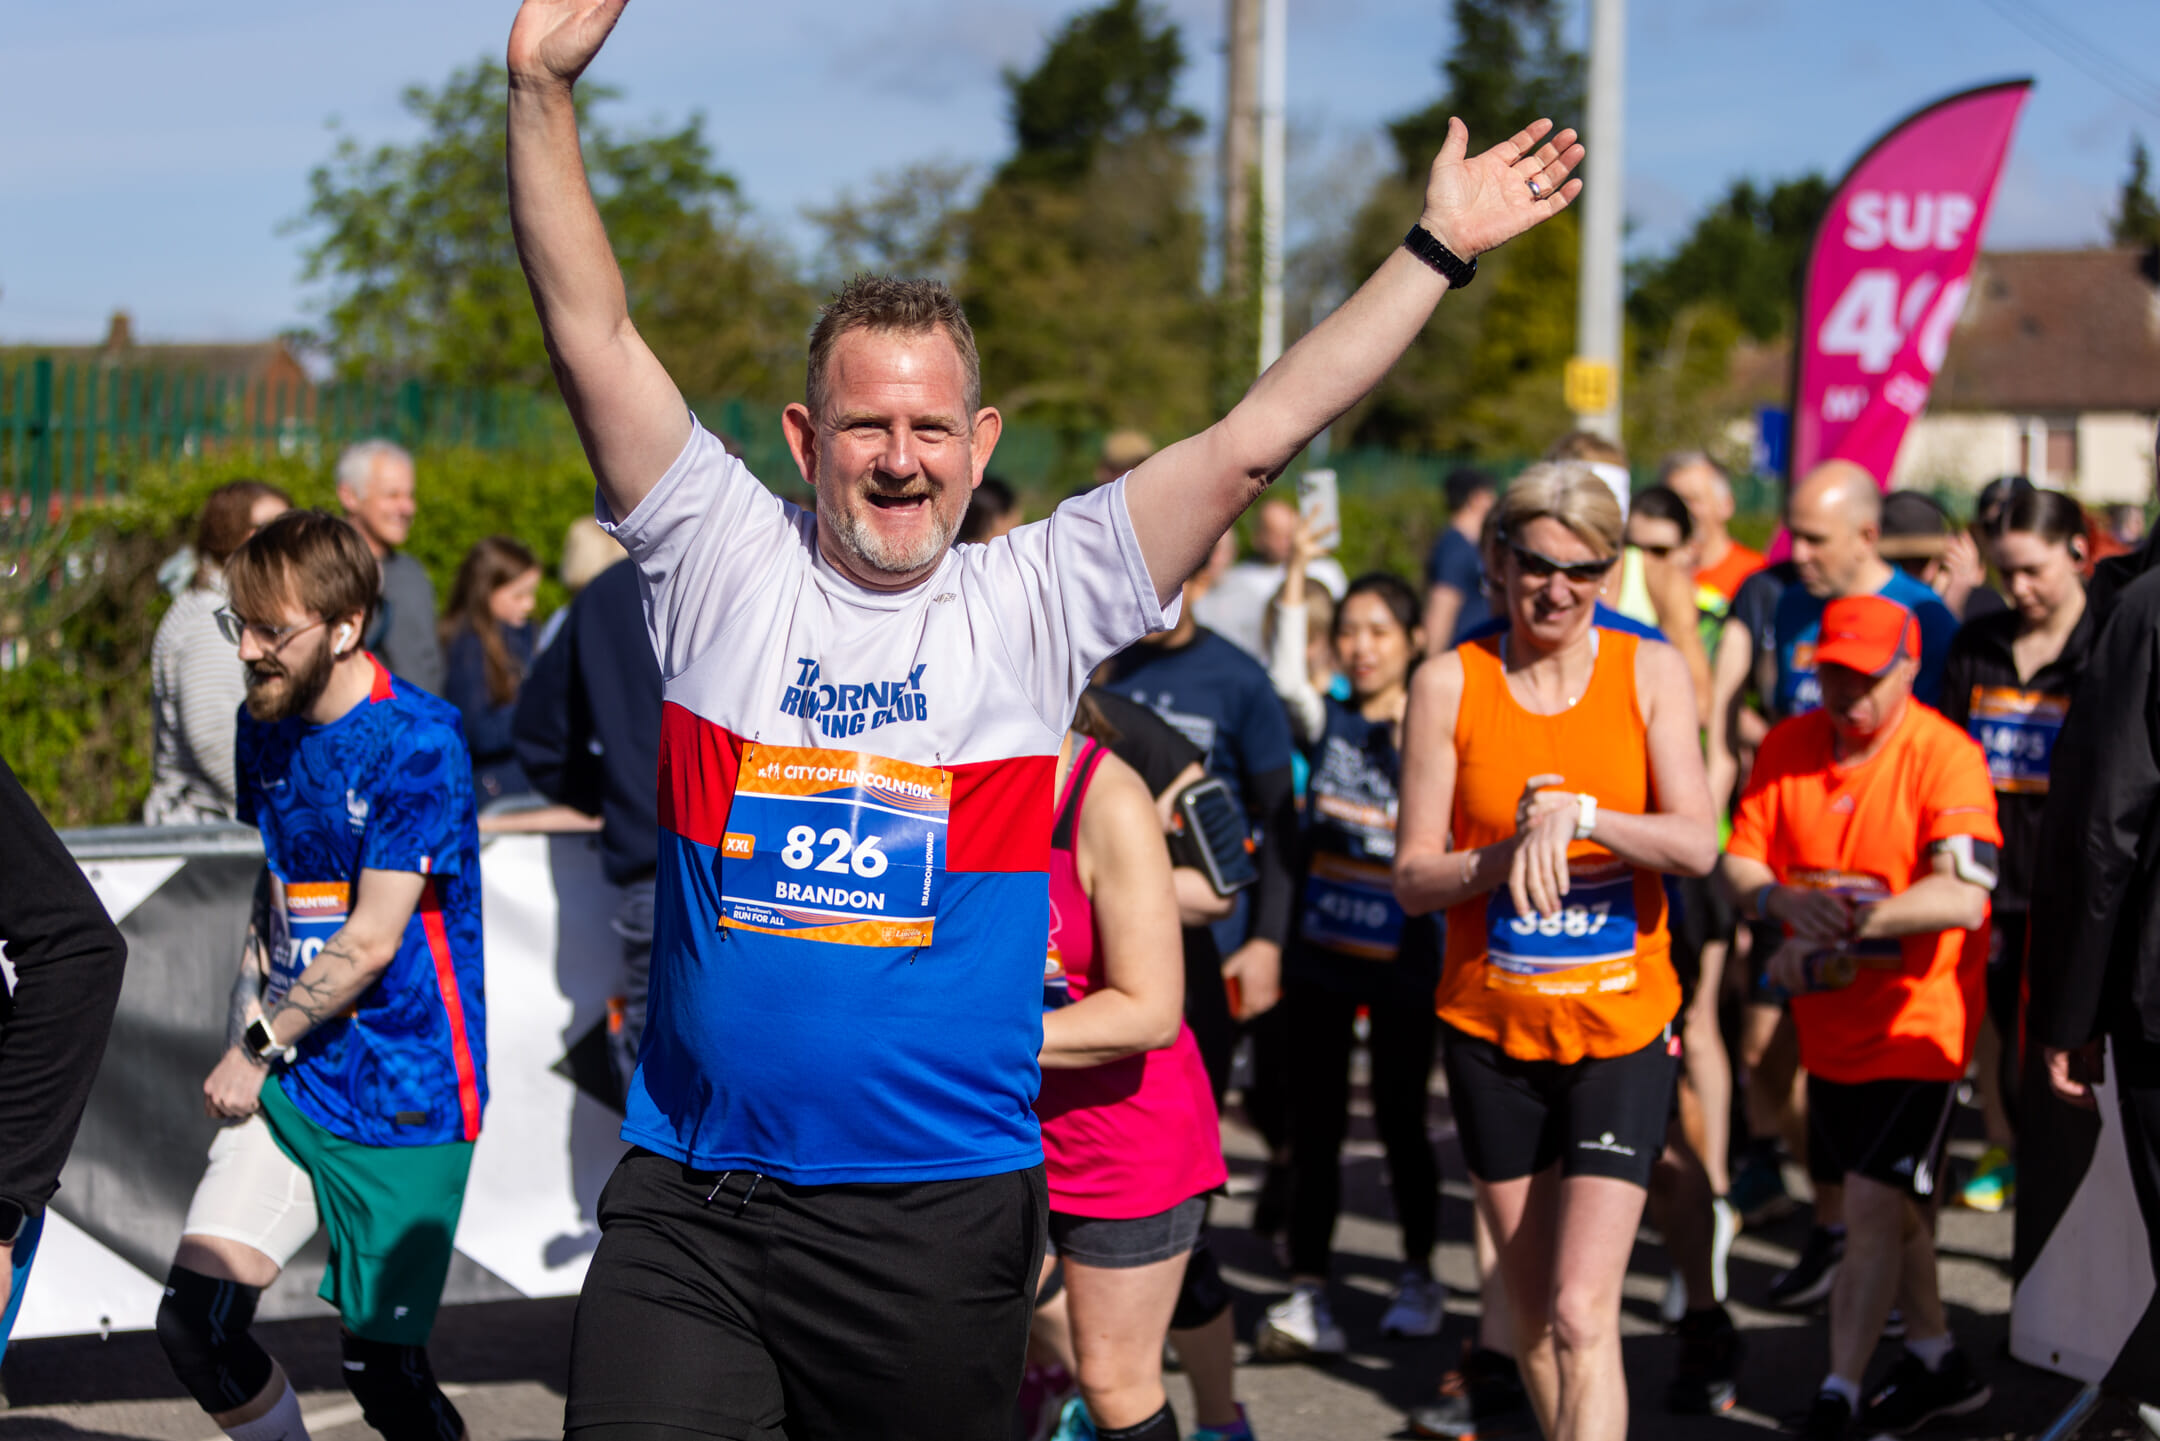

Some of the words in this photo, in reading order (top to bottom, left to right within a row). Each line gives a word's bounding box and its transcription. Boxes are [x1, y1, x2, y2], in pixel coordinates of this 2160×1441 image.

[779, 685, 866, 739] RUNING
[871, 692, 928, 730] CLUB
[725, 838, 750, 853] XXL
[781, 825, 889, 878] 826
[775, 880, 886, 910] BRANDON
[920, 865, 934, 907] BRANDON
[733, 910, 752, 921] RUN
[751, 913, 769, 924] FOR
[769, 916, 786, 926] ALL
